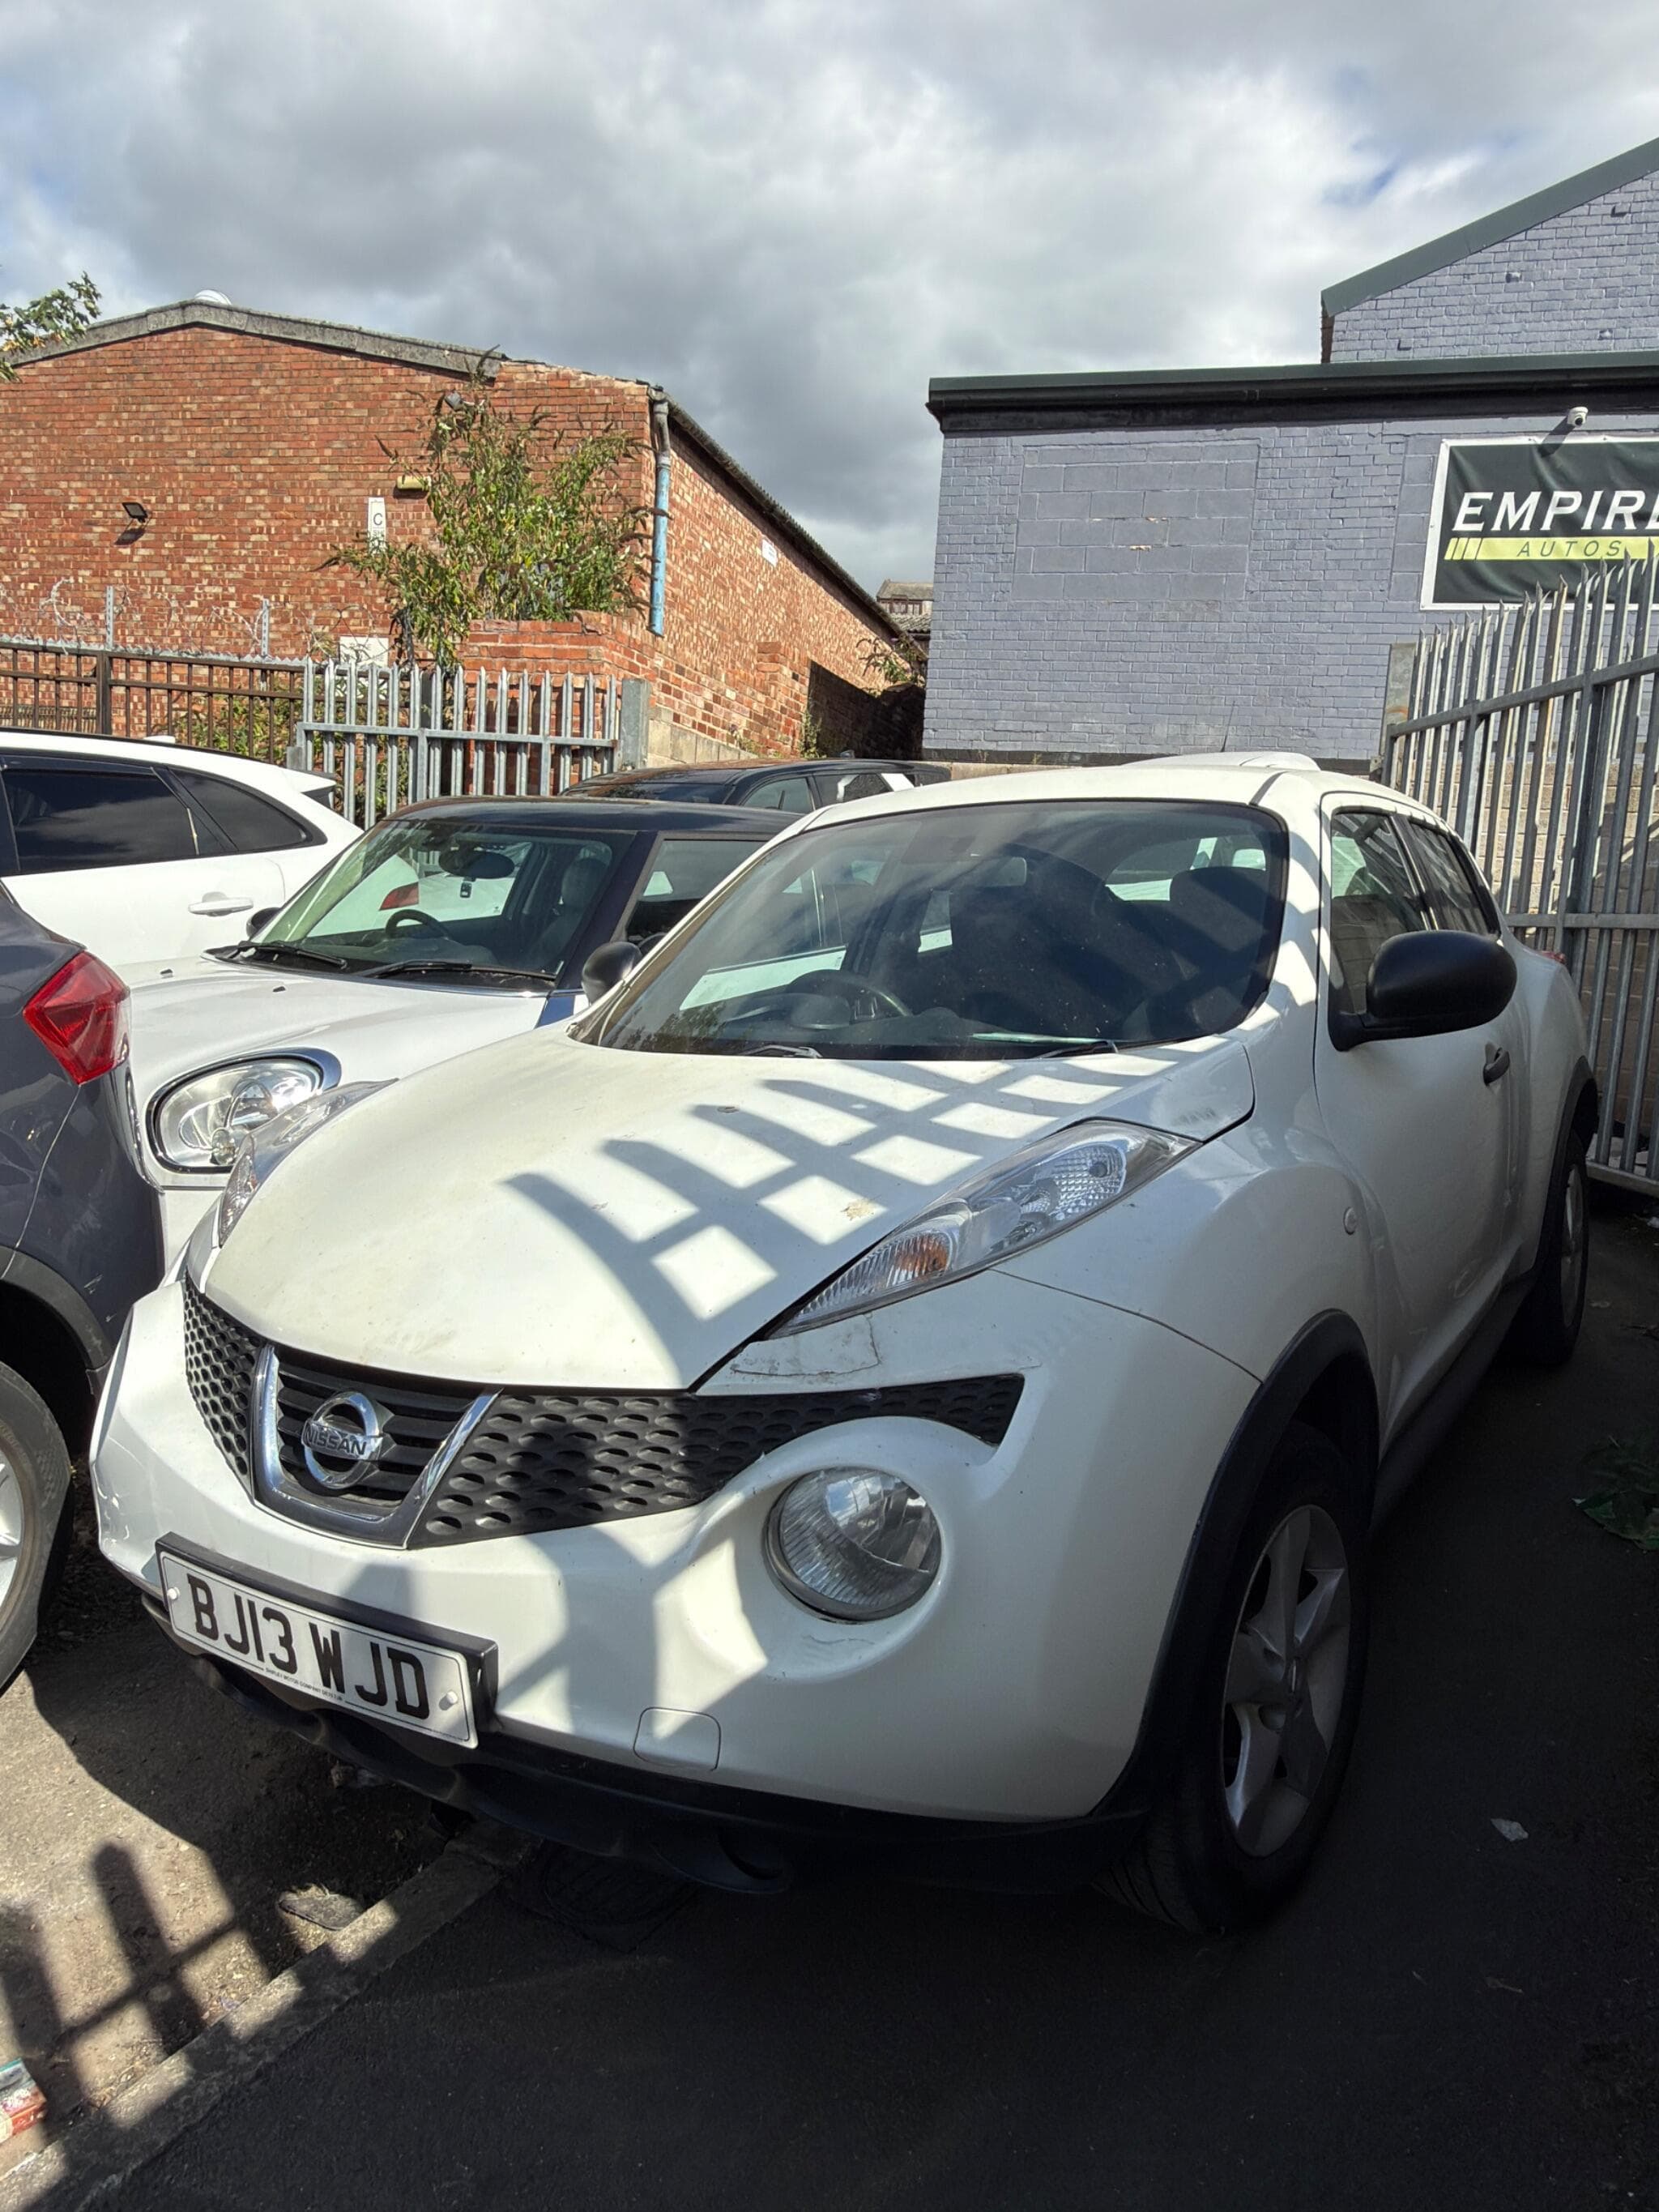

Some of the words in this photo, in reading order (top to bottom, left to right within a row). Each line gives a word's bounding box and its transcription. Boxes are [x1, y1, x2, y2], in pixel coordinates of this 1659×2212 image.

[373, 512, 383, 526] C
[1516, 540, 1622, 557] AUTOS
[304, 1428, 367, 1455] NISSAN
[187, 1574, 297, 1675] BJ13
[309, 1622, 430, 1720] WJD
